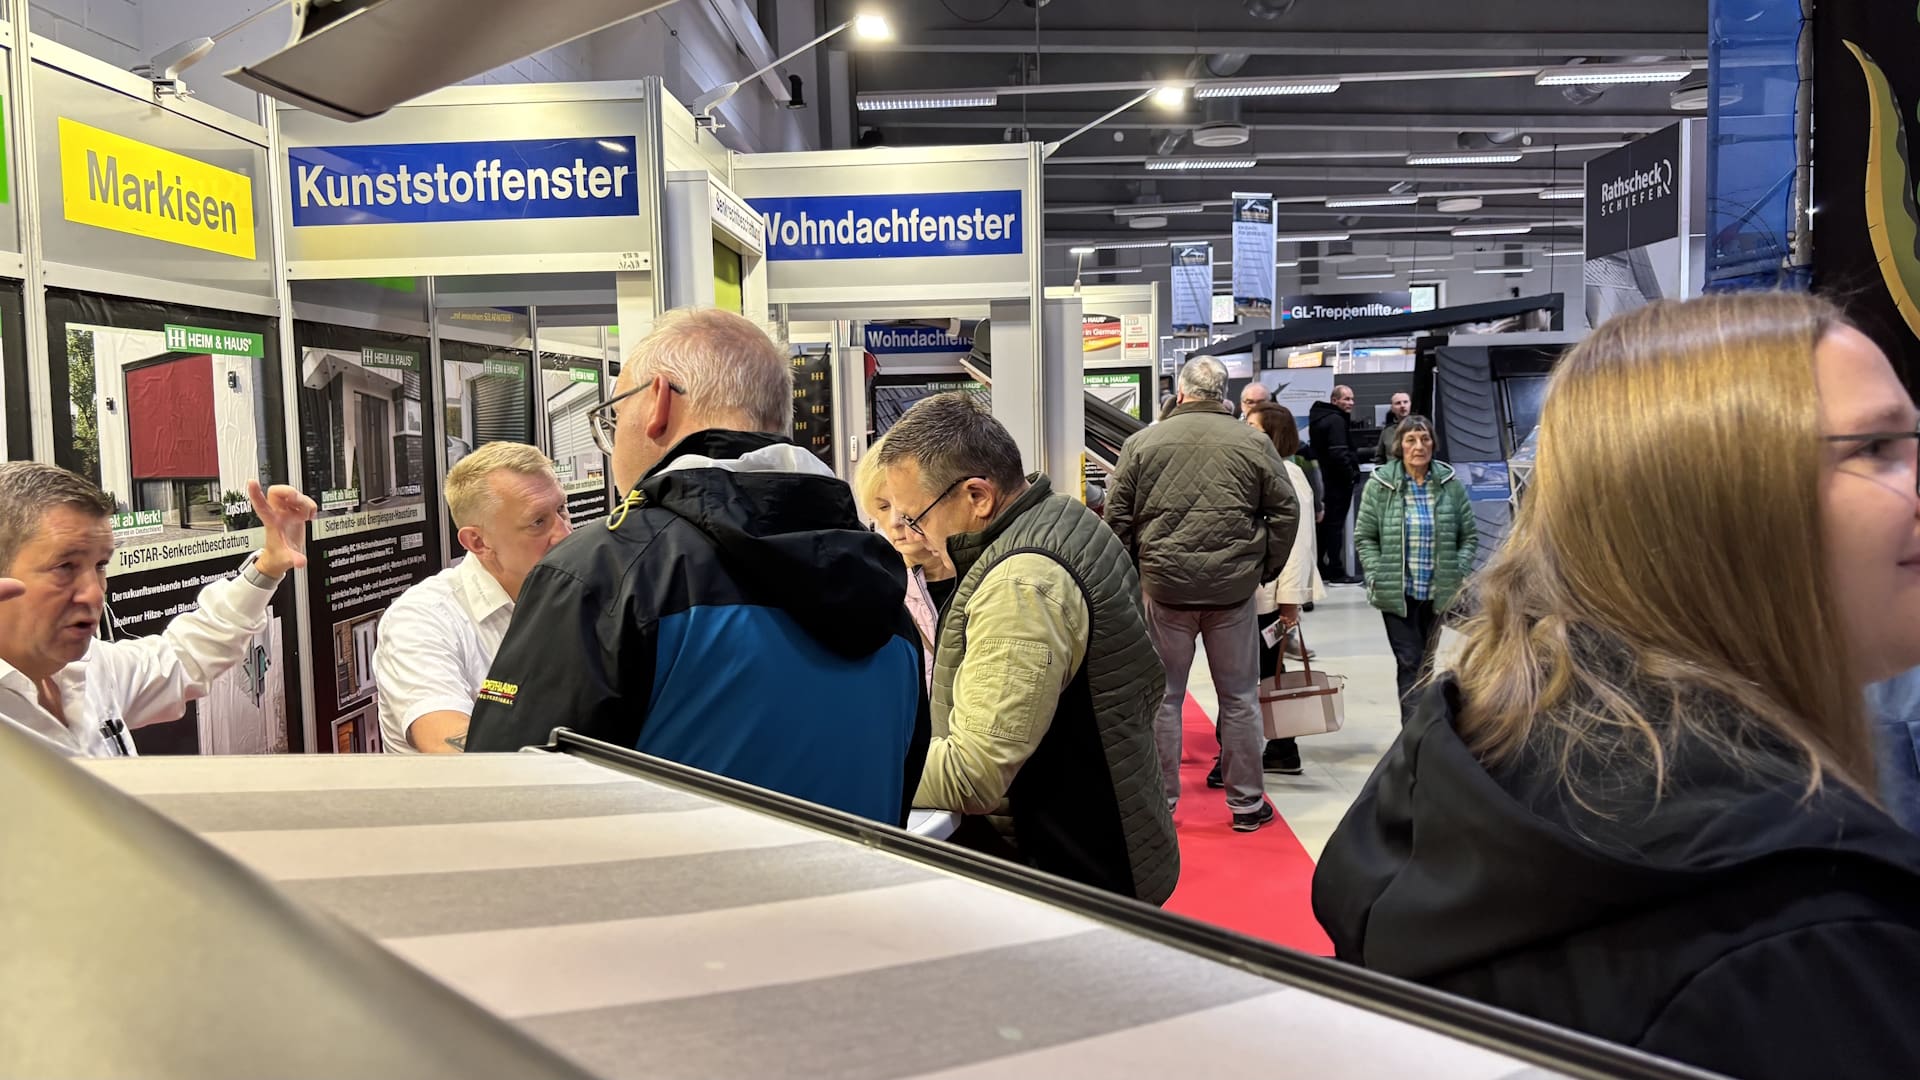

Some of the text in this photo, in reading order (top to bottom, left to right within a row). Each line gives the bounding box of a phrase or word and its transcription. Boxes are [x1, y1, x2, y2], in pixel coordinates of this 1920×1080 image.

[87, 149, 237, 235] Markisen
[298, 157, 629, 208] Kunststoffenster
[1601, 162, 1662, 203] Rathscheck
[1601, 185, 1662, 217] SCHIEFER
[188, 332, 213, 348] HEIM
[215, 335, 222, 349] &
[109, 510, 161, 528] ekt ab Werk!
[120, 535, 250, 568] ZipSTAR-Senkrechtbeschattung
[182, 577, 200, 588] textile
[144, 608, 164, 621] Hitze-
[164, 606, 178, 616] und
[178, 600, 200, 614] Blends
